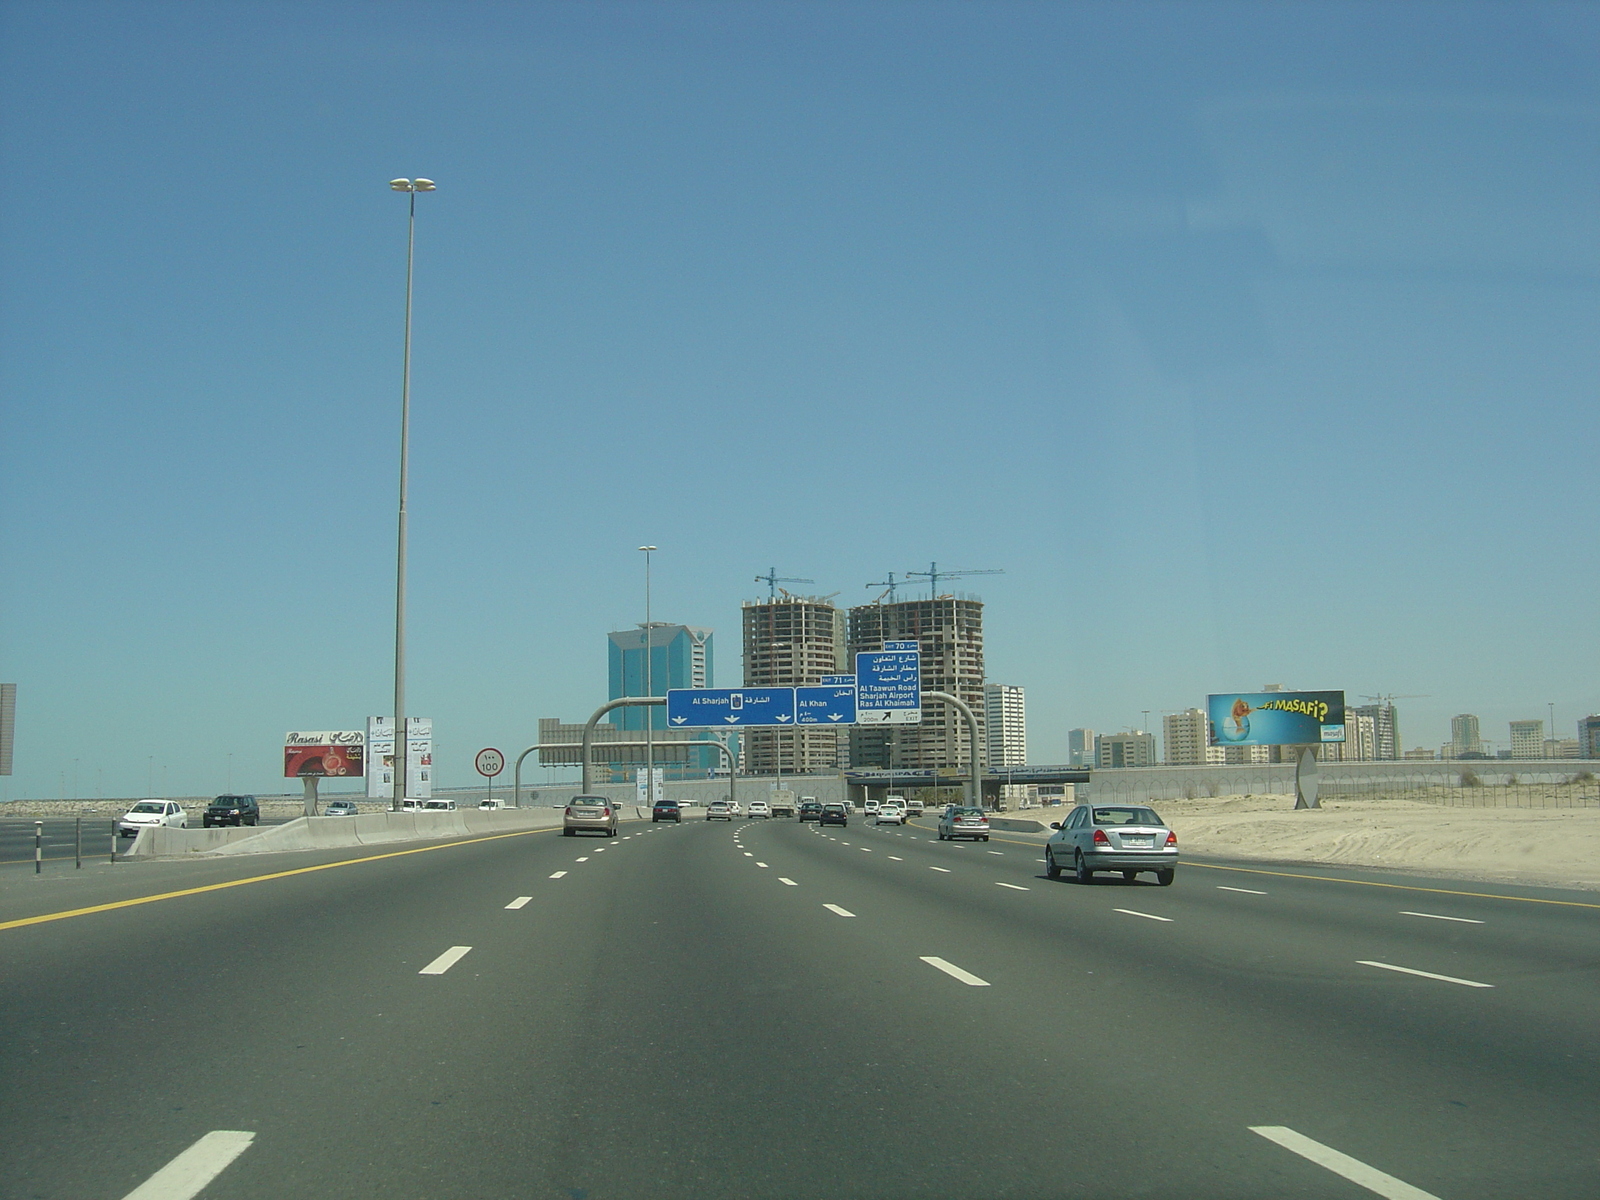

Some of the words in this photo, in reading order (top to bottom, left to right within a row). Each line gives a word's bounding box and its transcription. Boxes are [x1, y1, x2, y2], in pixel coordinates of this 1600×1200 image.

[872, 655, 896, 663] التعاون
[860, 693, 887, 701] Sharjah
[702, 697, 728, 706] Sharjah
[286, 732, 324, 744] Rasasi
[482, 763, 498, 771] 100
